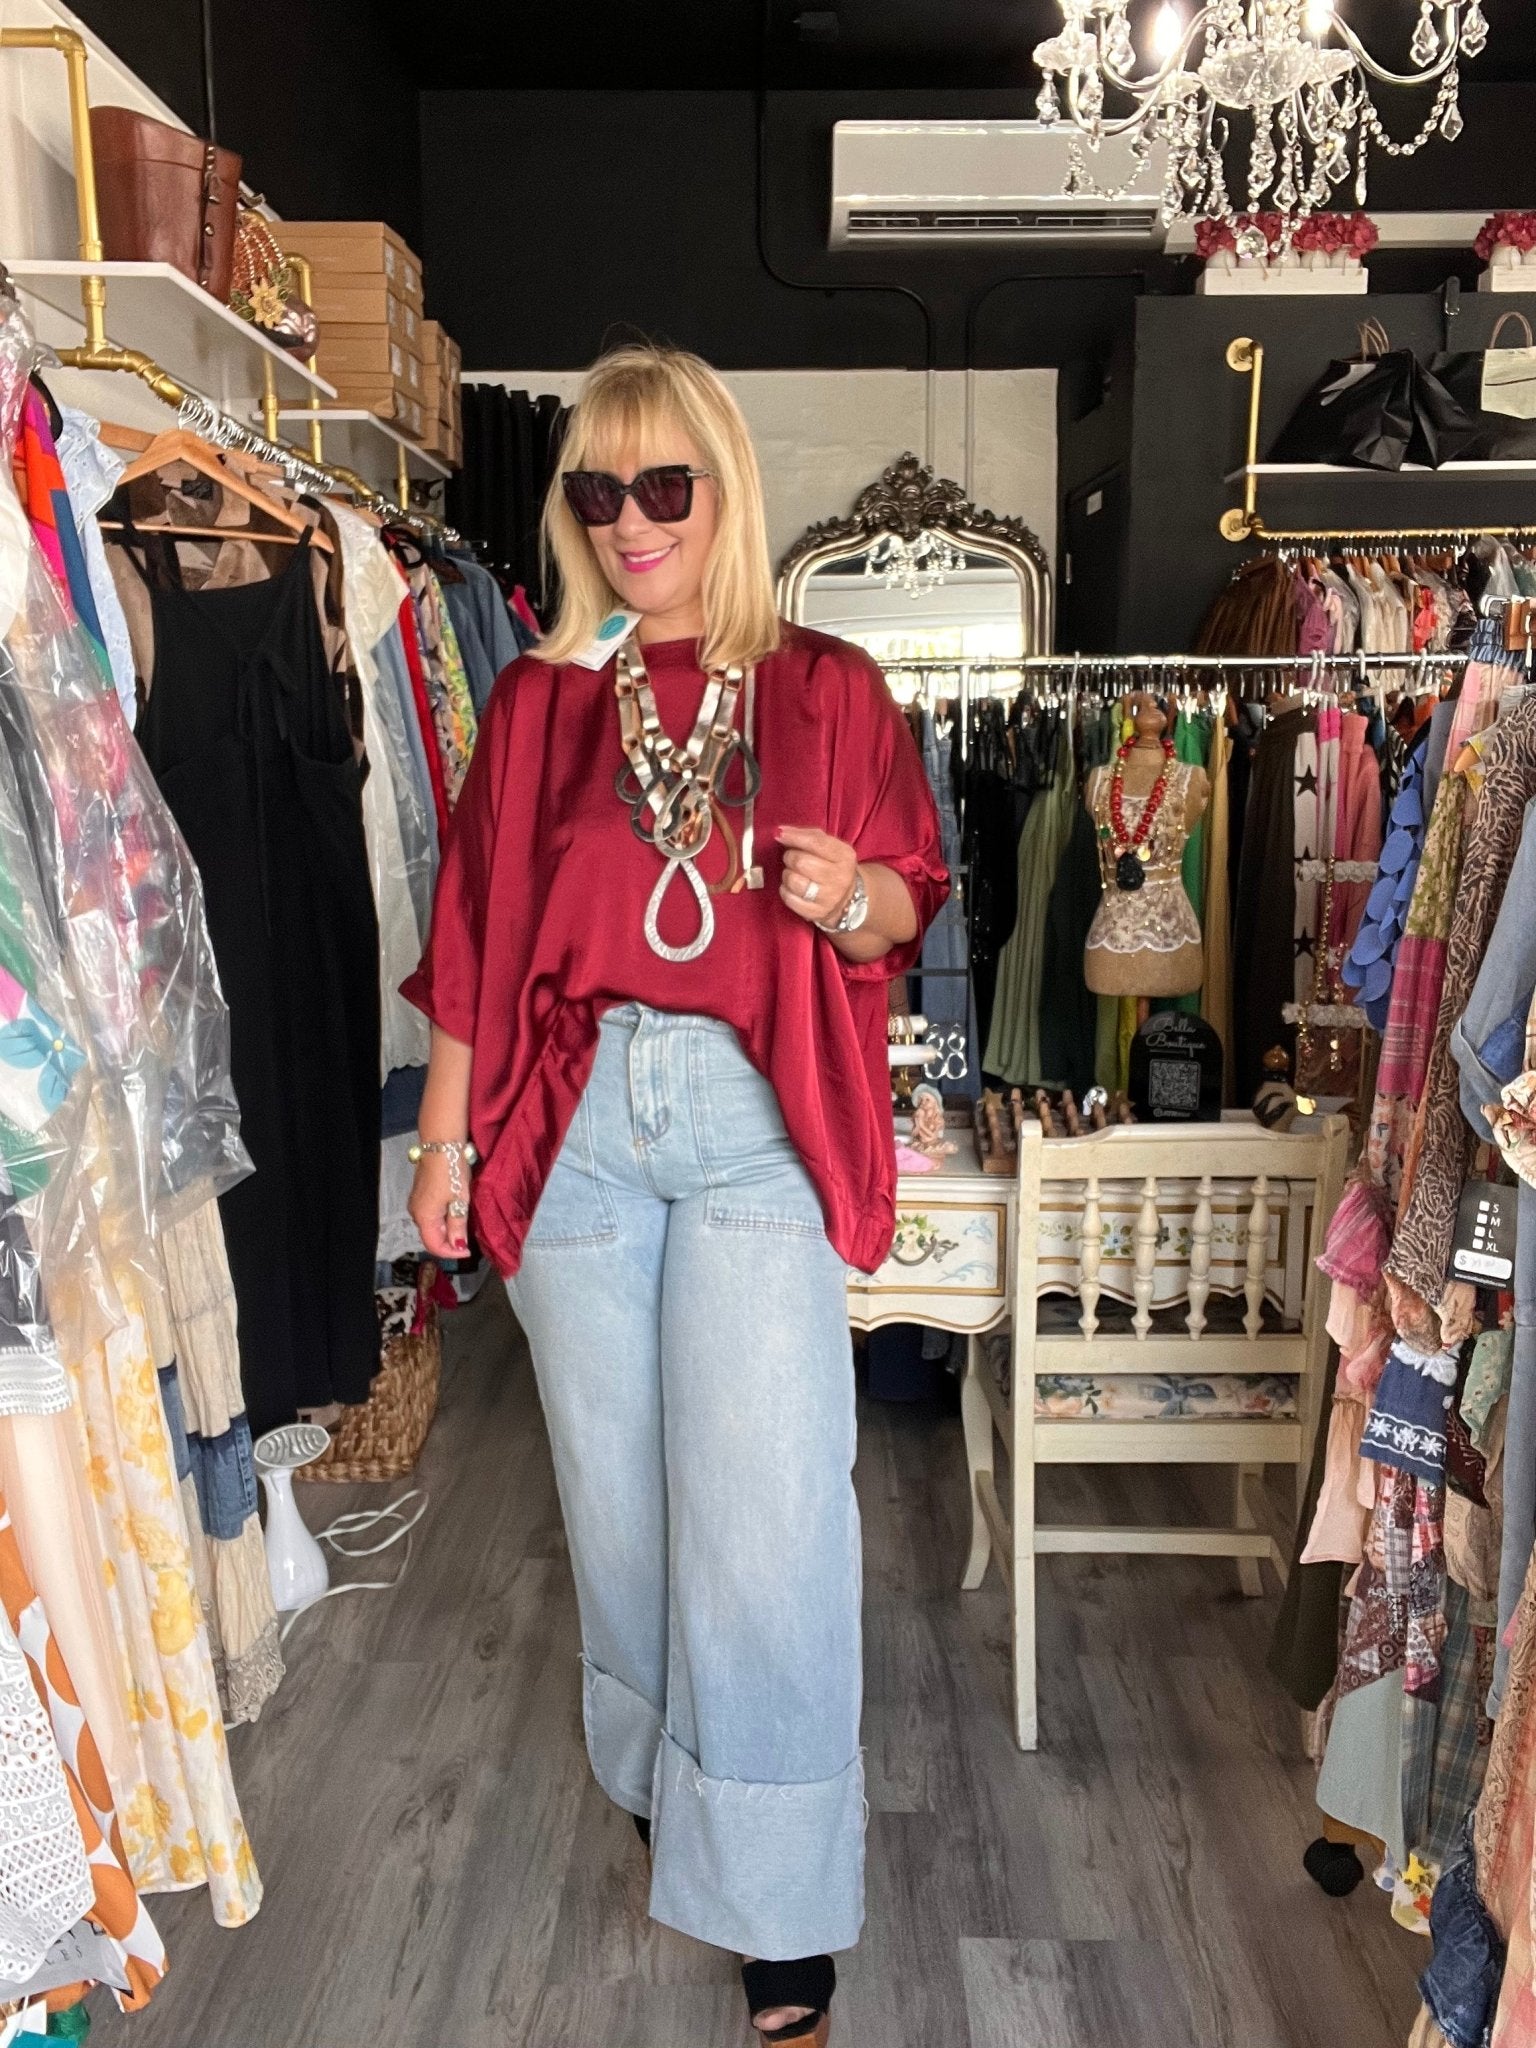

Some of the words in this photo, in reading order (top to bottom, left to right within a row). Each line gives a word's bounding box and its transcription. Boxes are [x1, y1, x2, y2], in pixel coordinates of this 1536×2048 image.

[1145, 1032, 1206, 1058] Boutique
[1492, 1203, 1500, 1213] S
[1490, 1216, 1501, 1227] M
[1488, 1229, 1495, 1239] L
[1485, 1241, 1499, 1253] XL
